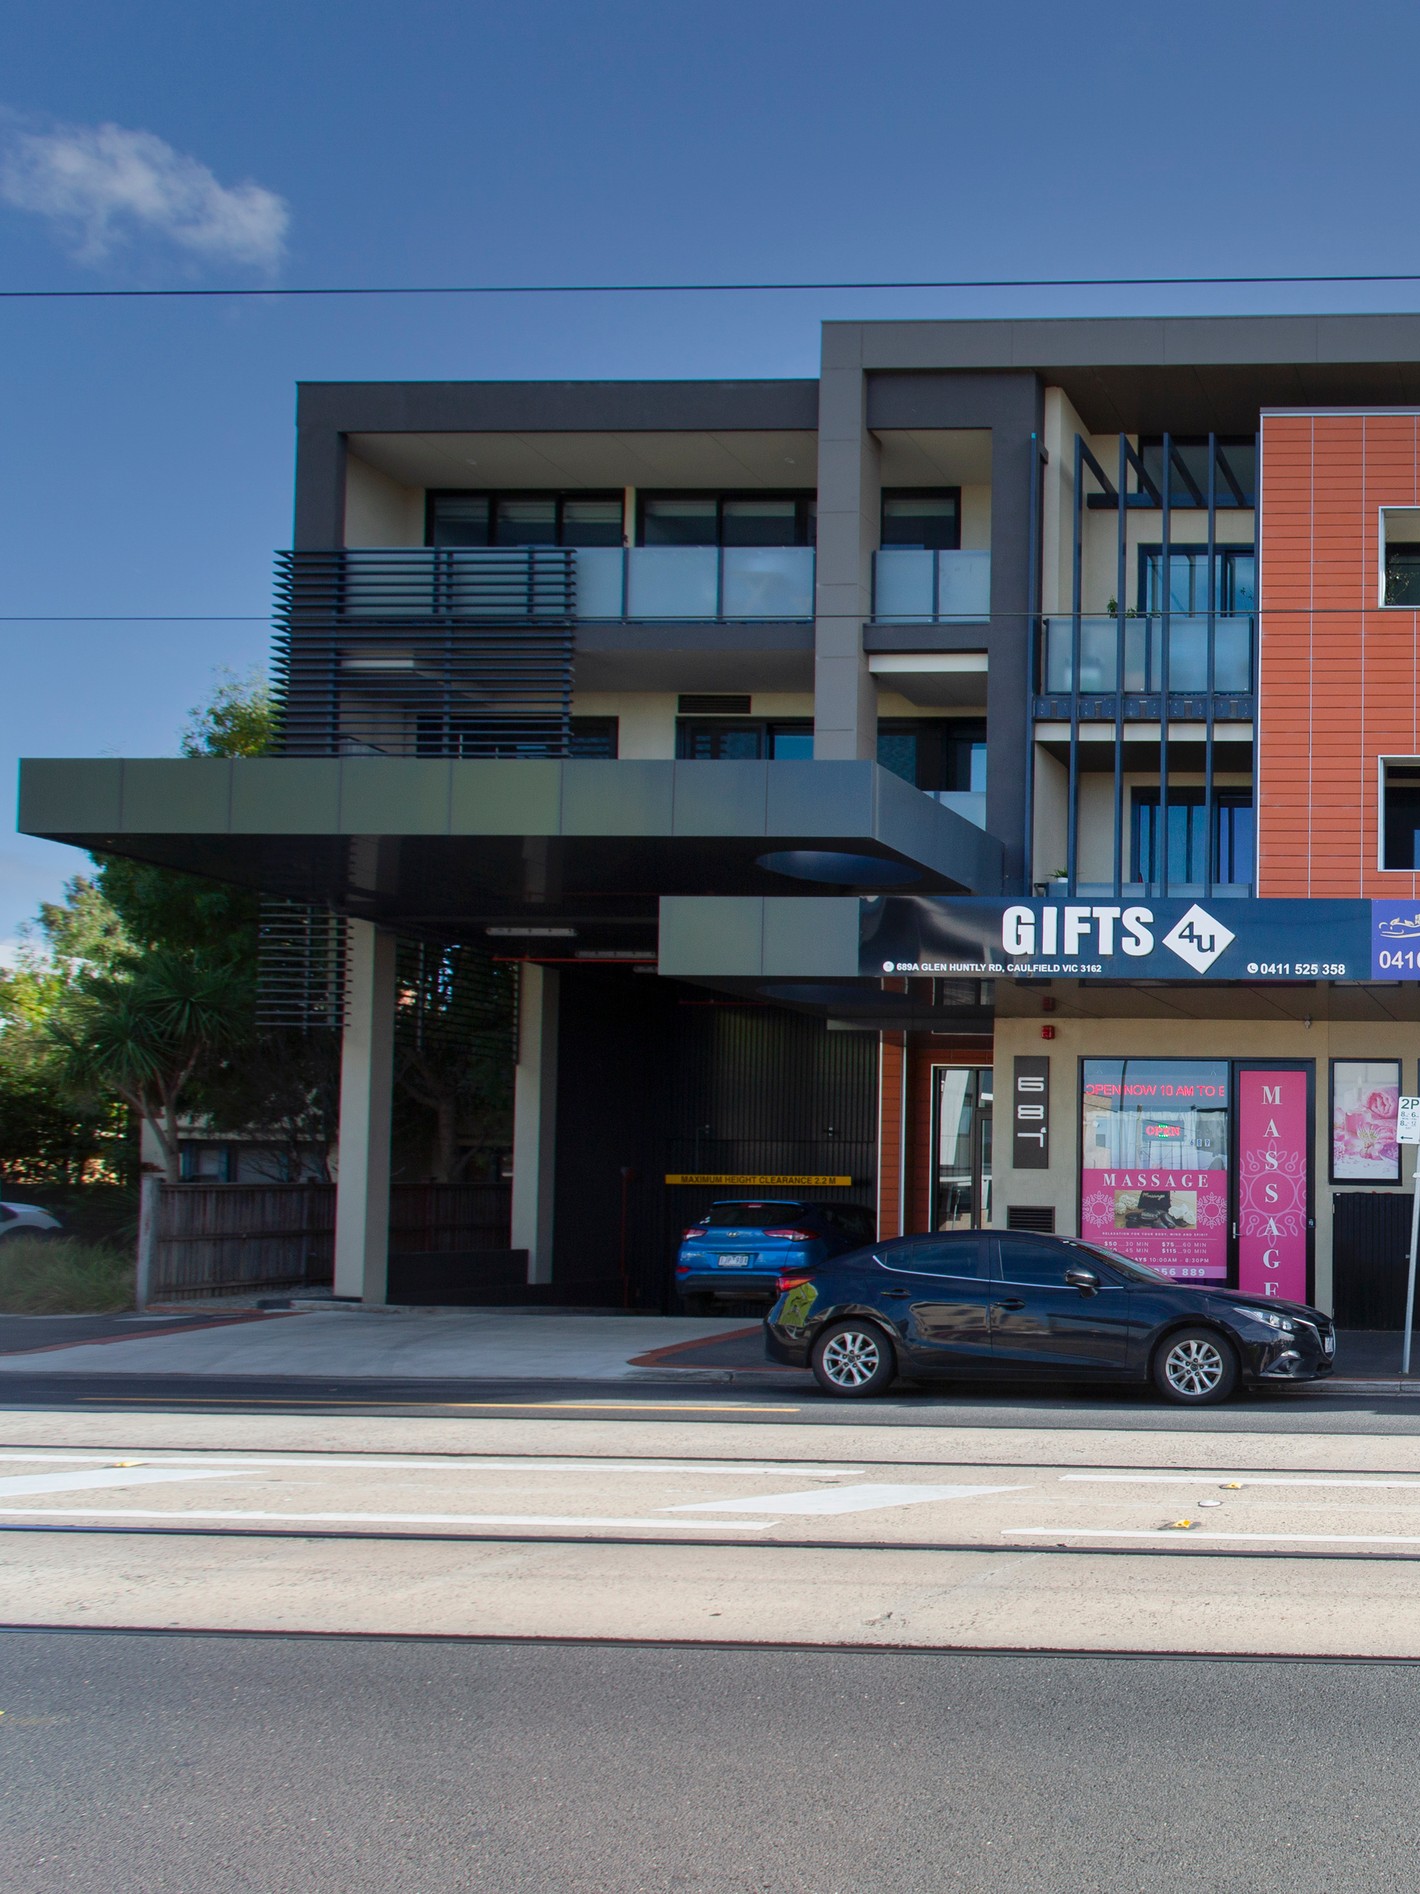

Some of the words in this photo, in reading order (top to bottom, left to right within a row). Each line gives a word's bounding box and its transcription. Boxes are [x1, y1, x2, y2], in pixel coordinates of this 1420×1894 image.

[1002, 905, 1154, 956] GIFTS
[896, 963, 919, 972] 689A
[921, 963, 947, 972] GLEN
[949, 963, 987, 972] HUNTLY
[989, 963, 1005, 973] RD,
[1007, 963, 1060, 973] CAULFIELD
[1063, 964, 1078, 973] VIC
[1080, 964, 1102, 973] 3162
[1261, 963, 1290, 975] 0411
[1294, 964, 1318, 975] 525
[1322, 964, 1346, 975] 358
[1085, 1084, 1121, 1096] OPEN
[1123, 1084, 1157, 1096] NOW
[1161, 1085, 1173, 1096] 10
[1176, 1086, 1194, 1097] AM
[1196, 1085, 1215, 1097] TO
[1401, 1098, 1420, 1110] 2P
[1145, 1125, 1181, 1137] OPEN
[681, 1175, 722, 1184] MAXIMUM
[725, 1176, 757, 1184] HEIGHT
[759, 1176, 812, 1185] CLEARANCE
[814, 1177, 827, 1185] 2.2
[829, 1177, 836, 1185] M
[1103, 1173, 1209, 1188] MASSAGE
[1261, 1086, 1282, 1298] MASSAGE
[1182, 1268, 1205, 1276] 889
